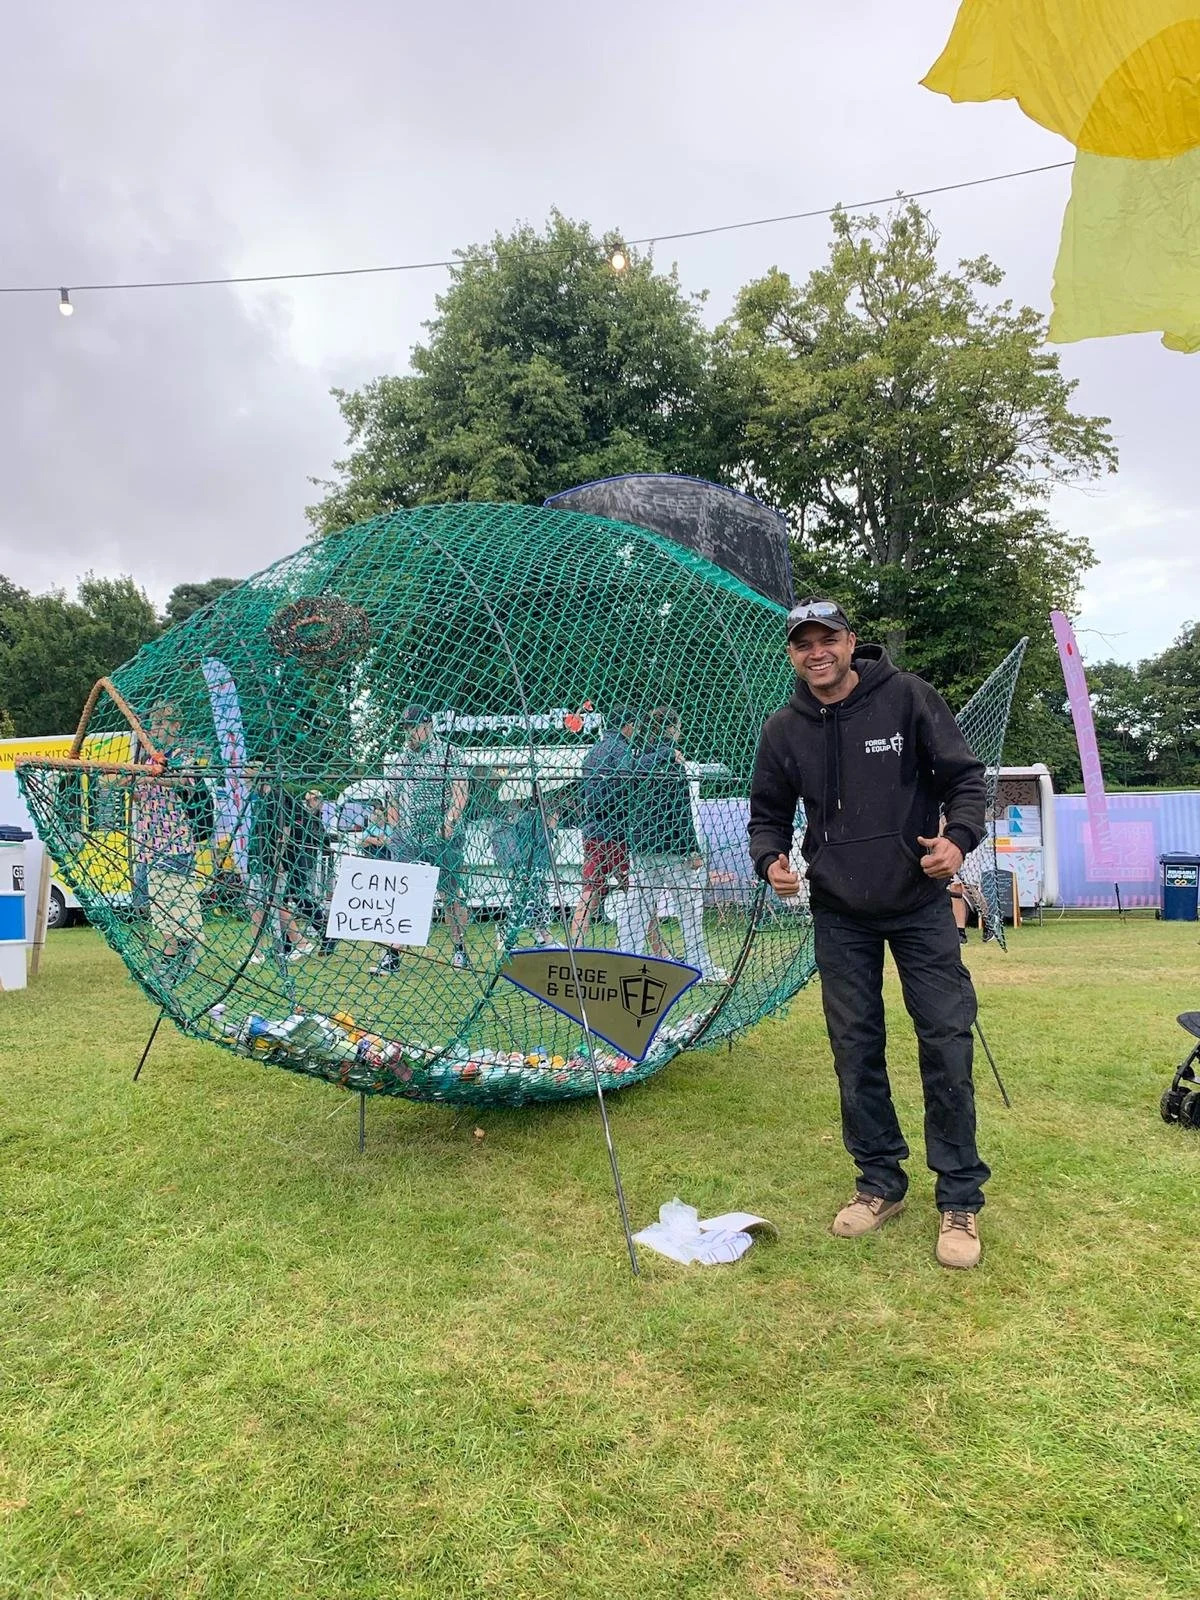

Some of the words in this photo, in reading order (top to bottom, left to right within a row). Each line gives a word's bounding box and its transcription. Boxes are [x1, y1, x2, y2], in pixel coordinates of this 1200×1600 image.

[871, 745, 891, 753] EQUIP
[351, 872, 409, 895] CANS
[348, 896, 396, 917] ONLY
[335, 911, 413, 935] PLEASE
[548, 965, 608, 985] FORGE
[547, 982, 559, 997] &
[564, 984, 618, 1002] EQUIP
